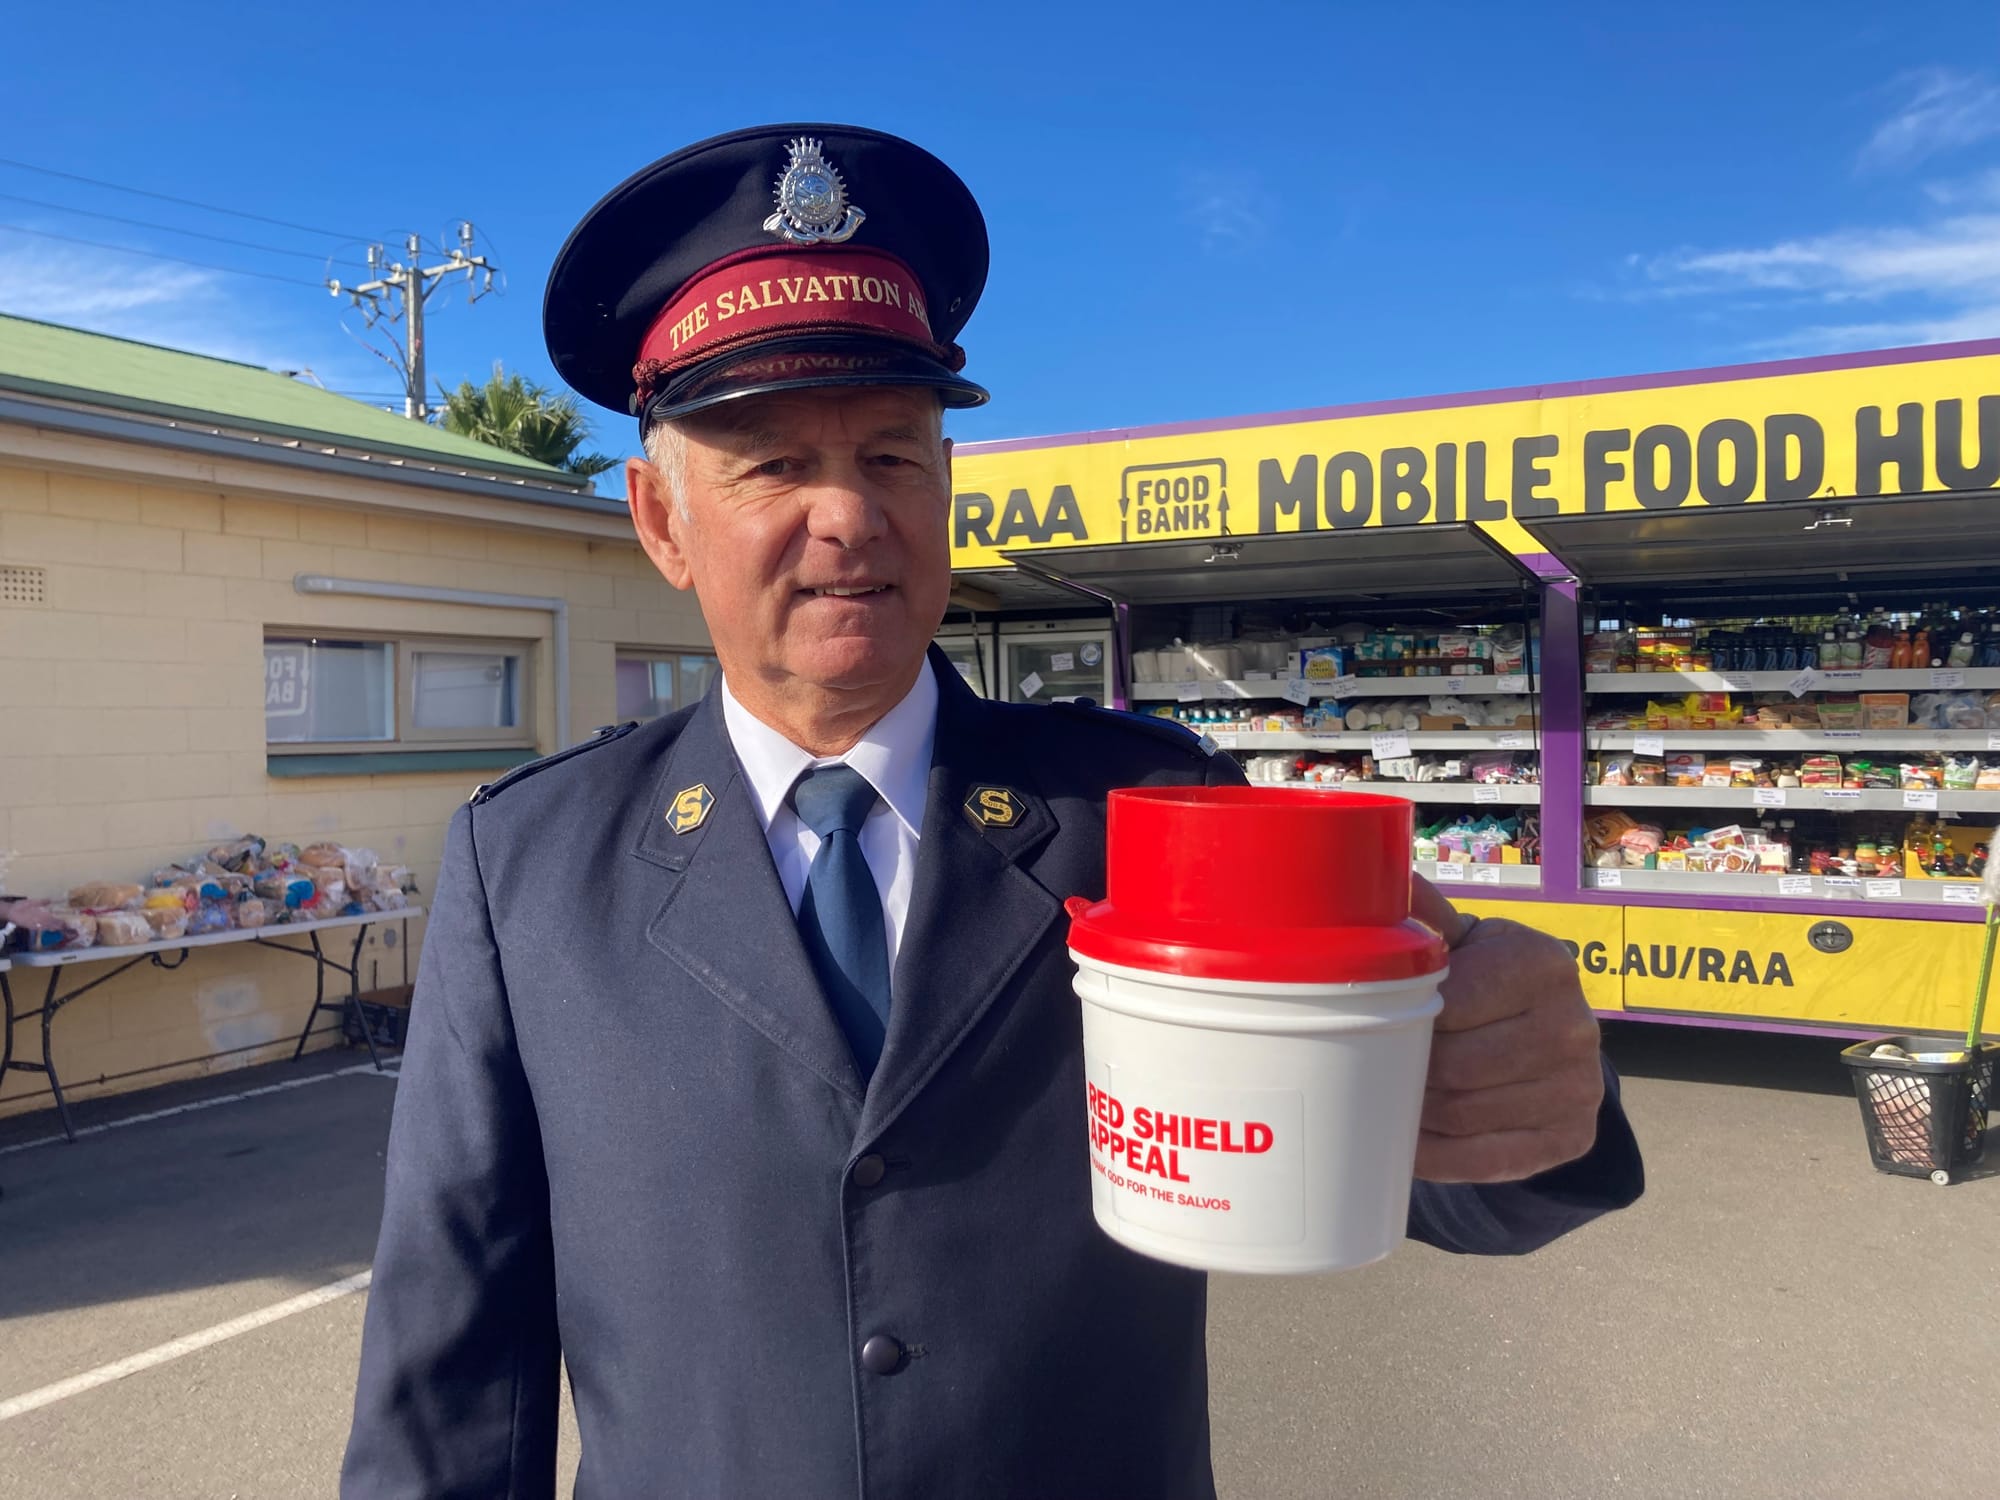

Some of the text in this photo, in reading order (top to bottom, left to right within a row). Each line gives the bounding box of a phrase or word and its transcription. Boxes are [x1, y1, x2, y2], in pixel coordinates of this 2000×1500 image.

[670, 302, 710, 351] THE
[716, 275, 901, 321] SALVATION
[1137, 476, 1210, 504] FOOD
[1258, 395, 2000, 534] MOBILE FOOD HU
[954, 485, 1088, 548] RAA
[1137, 504, 1210, 535] BANK
[676, 786, 704, 831] S
[980, 790, 1013, 822] S
[1088, 1080, 1274, 1154] RED SHIELD
[1090, 1116, 1191, 1183] APPEAL
[1107, 1169, 1125, 1187] GOD
[1126, 1179, 1147, 1197] FOR
[1149, 1187, 1174, 1203] THE
[1177, 1194, 1231, 1211] SALVOS
